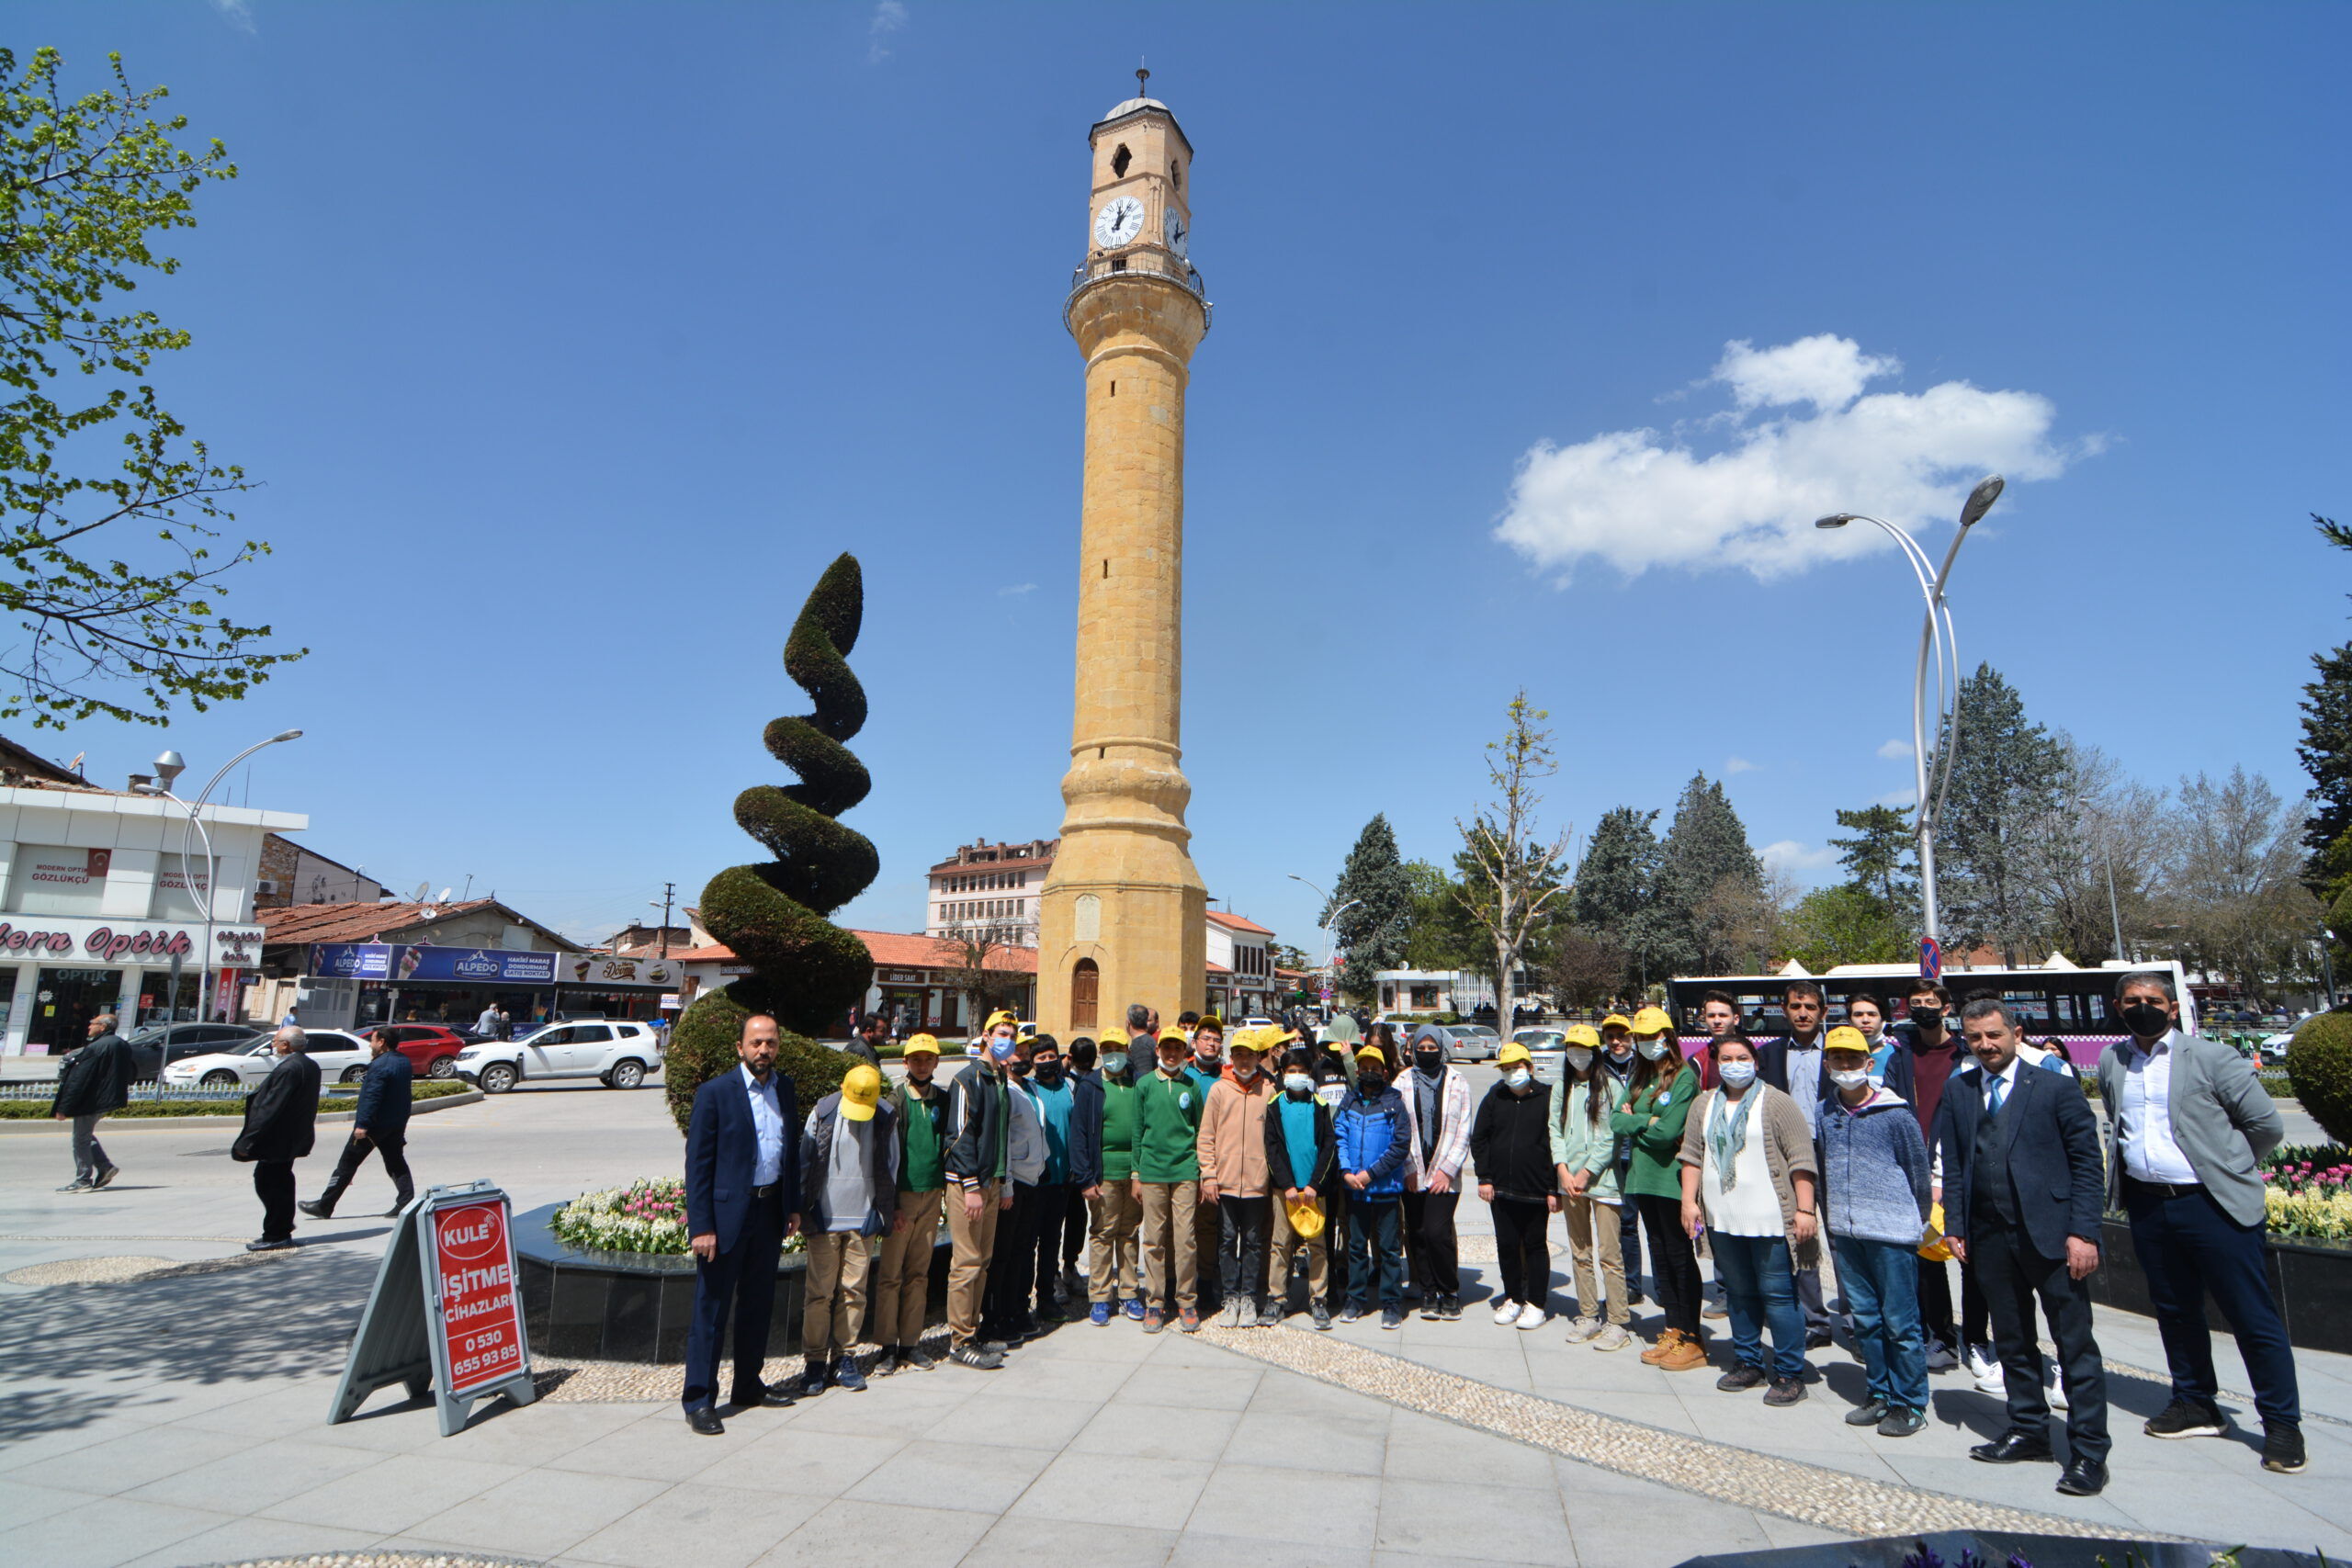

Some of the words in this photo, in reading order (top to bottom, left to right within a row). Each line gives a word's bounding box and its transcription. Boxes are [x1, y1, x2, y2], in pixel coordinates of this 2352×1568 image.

[36, 863, 66, 872] MODERN
[31, 873, 89, 885] GÖZLÜKÇÜ
[85, 927, 191, 961] Optik
[334, 958, 360, 968] ALPEDO
[457, 962, 498, 972] ALPEDO
[889, 972, 903, 982] LİDER
[1325, 1074, 1339, 1082] NEW
[444, 1224, 490, 1247] KULE
[441, 1263, 510, 1303] İŞİTME
[446, 1292, 514, 1323] CİHAZLARI
[465, 1338, 475, 1352] 0
[477, 1330, 503, 1349] 530
[454, 1356, 481, 1376] 655
[481, 1350, 500, 1367] 93
[501, 1344, 517, 1359] 85
